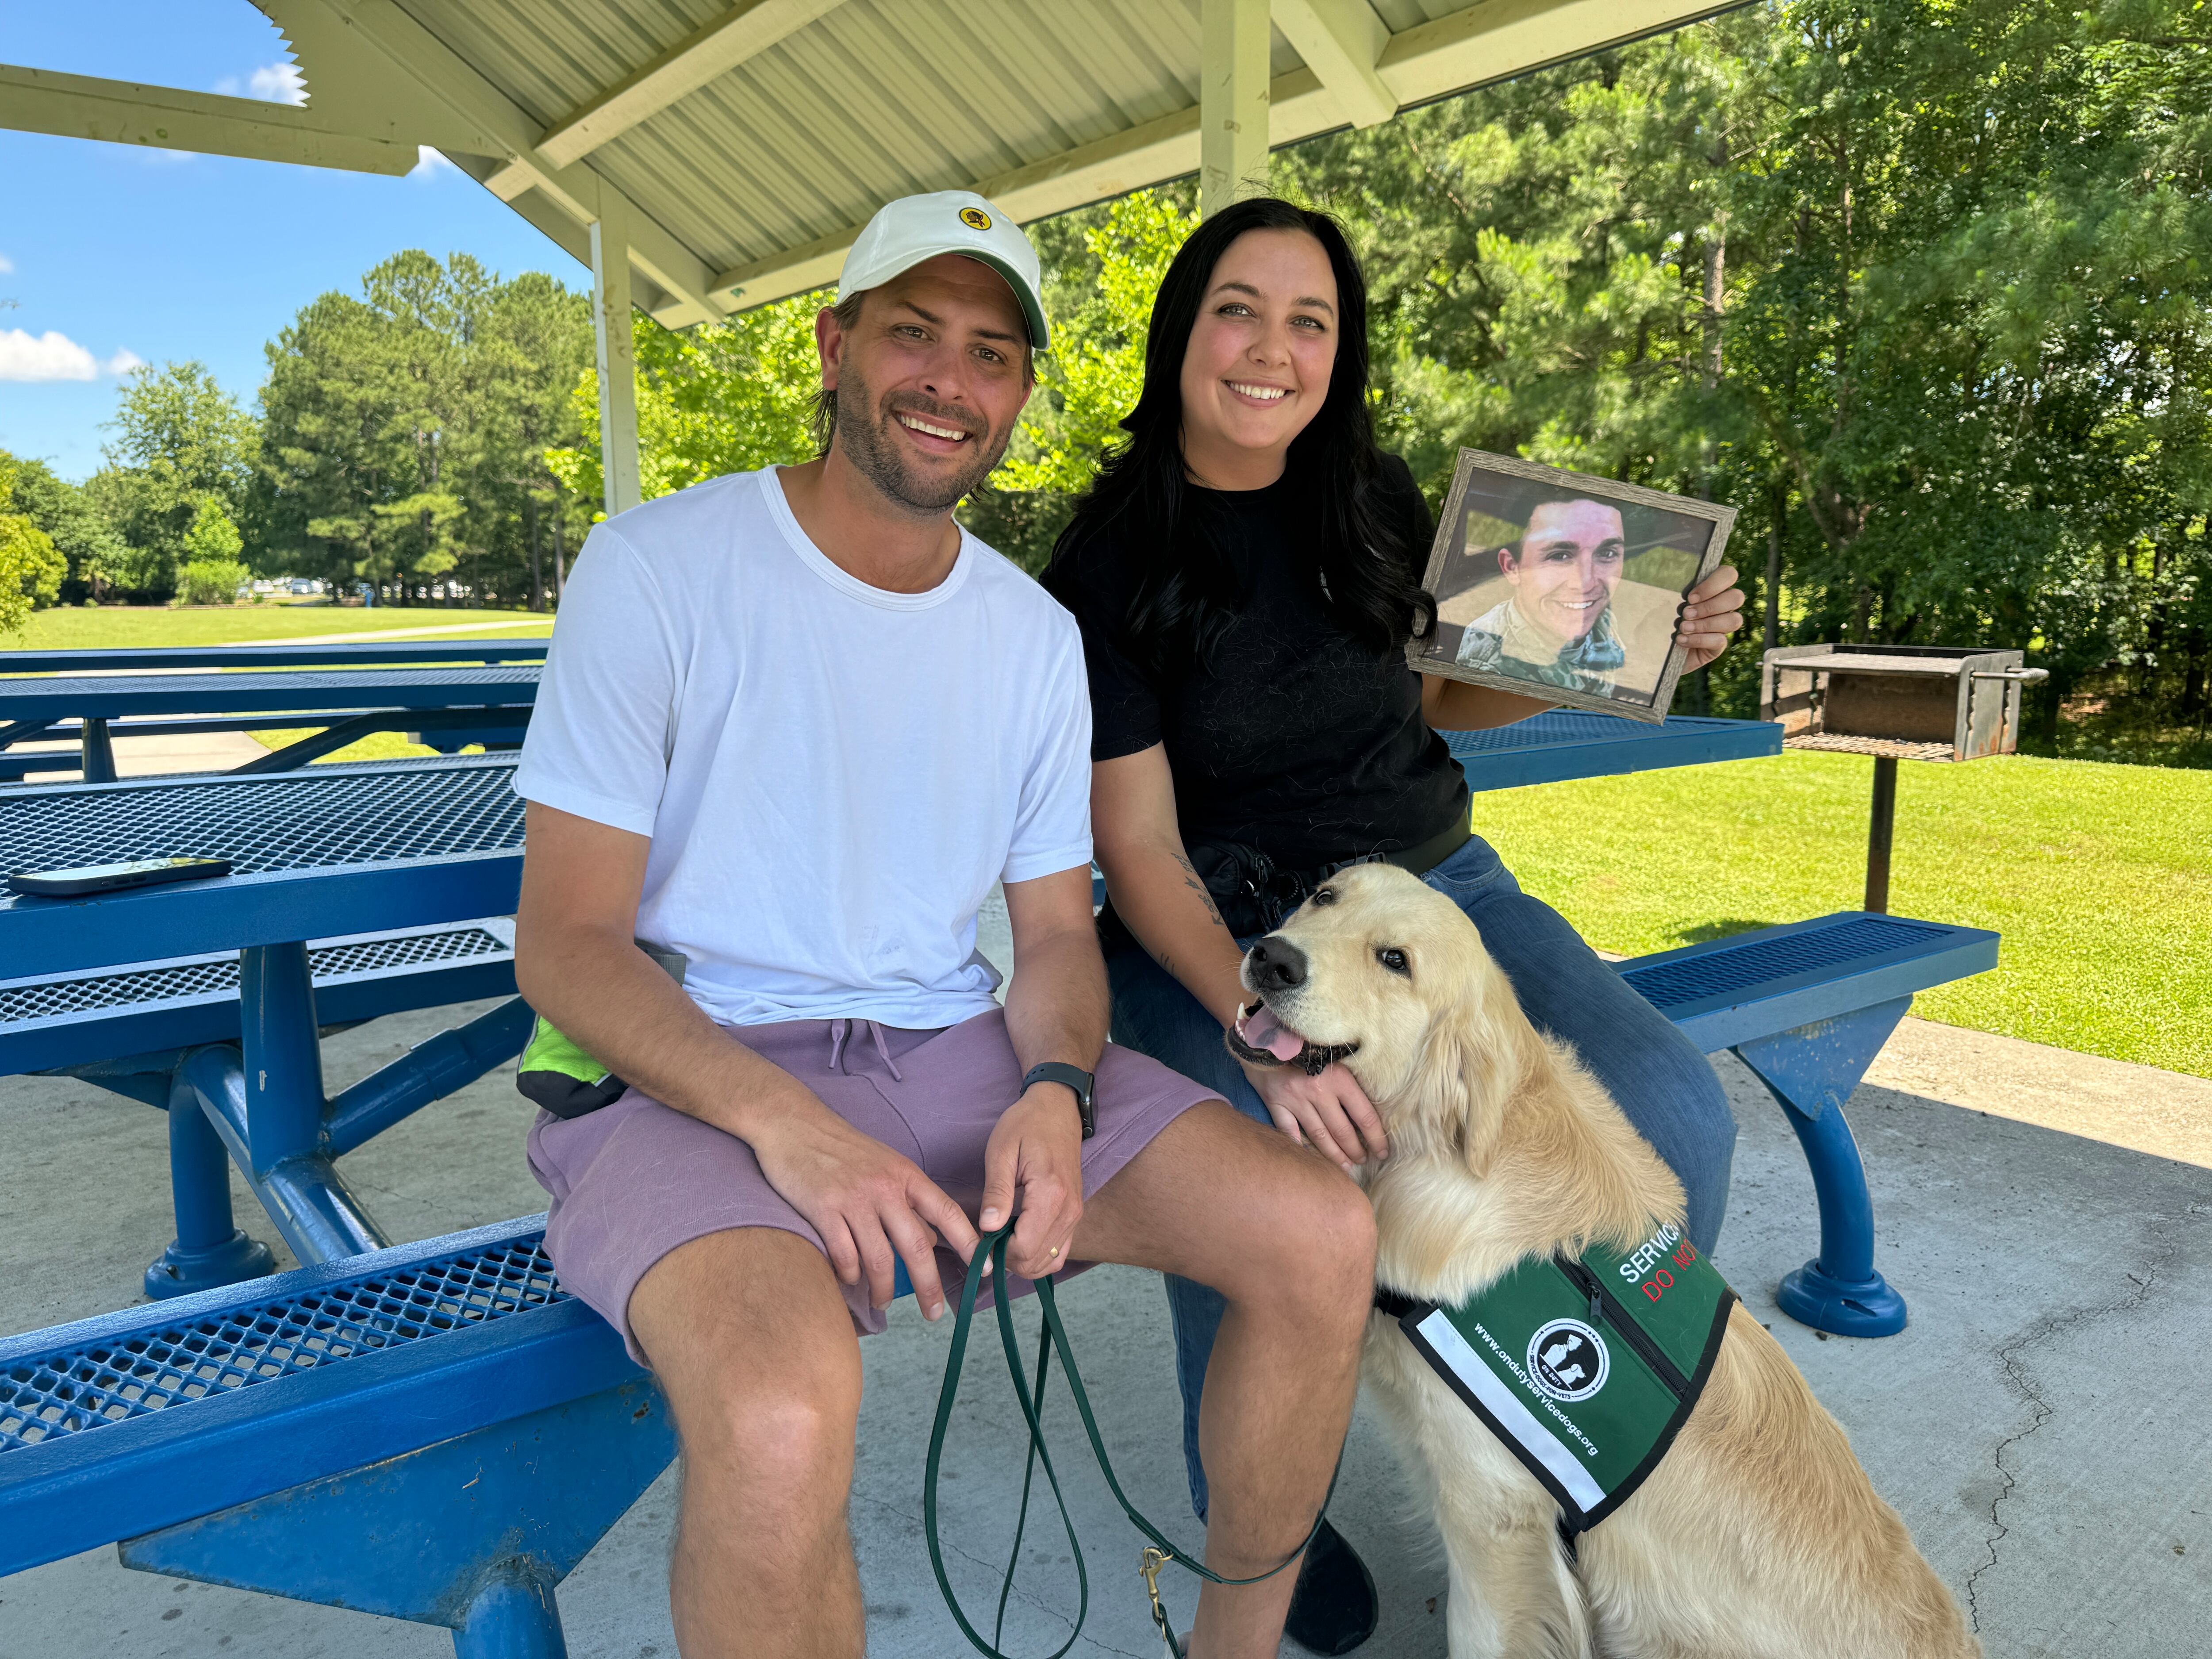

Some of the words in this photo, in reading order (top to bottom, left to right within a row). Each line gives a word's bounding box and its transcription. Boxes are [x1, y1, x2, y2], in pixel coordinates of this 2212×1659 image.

[1642, 1269, 1674, 1302] DO
[1672, 1238, 1696, 1271] NO
[1475, 1323, 1599, 1456] www.ondutyservicedogs.org
[1541, 1365, 1550, 1374] ON
[1548, 1372, 1562, 1386] DUTY
